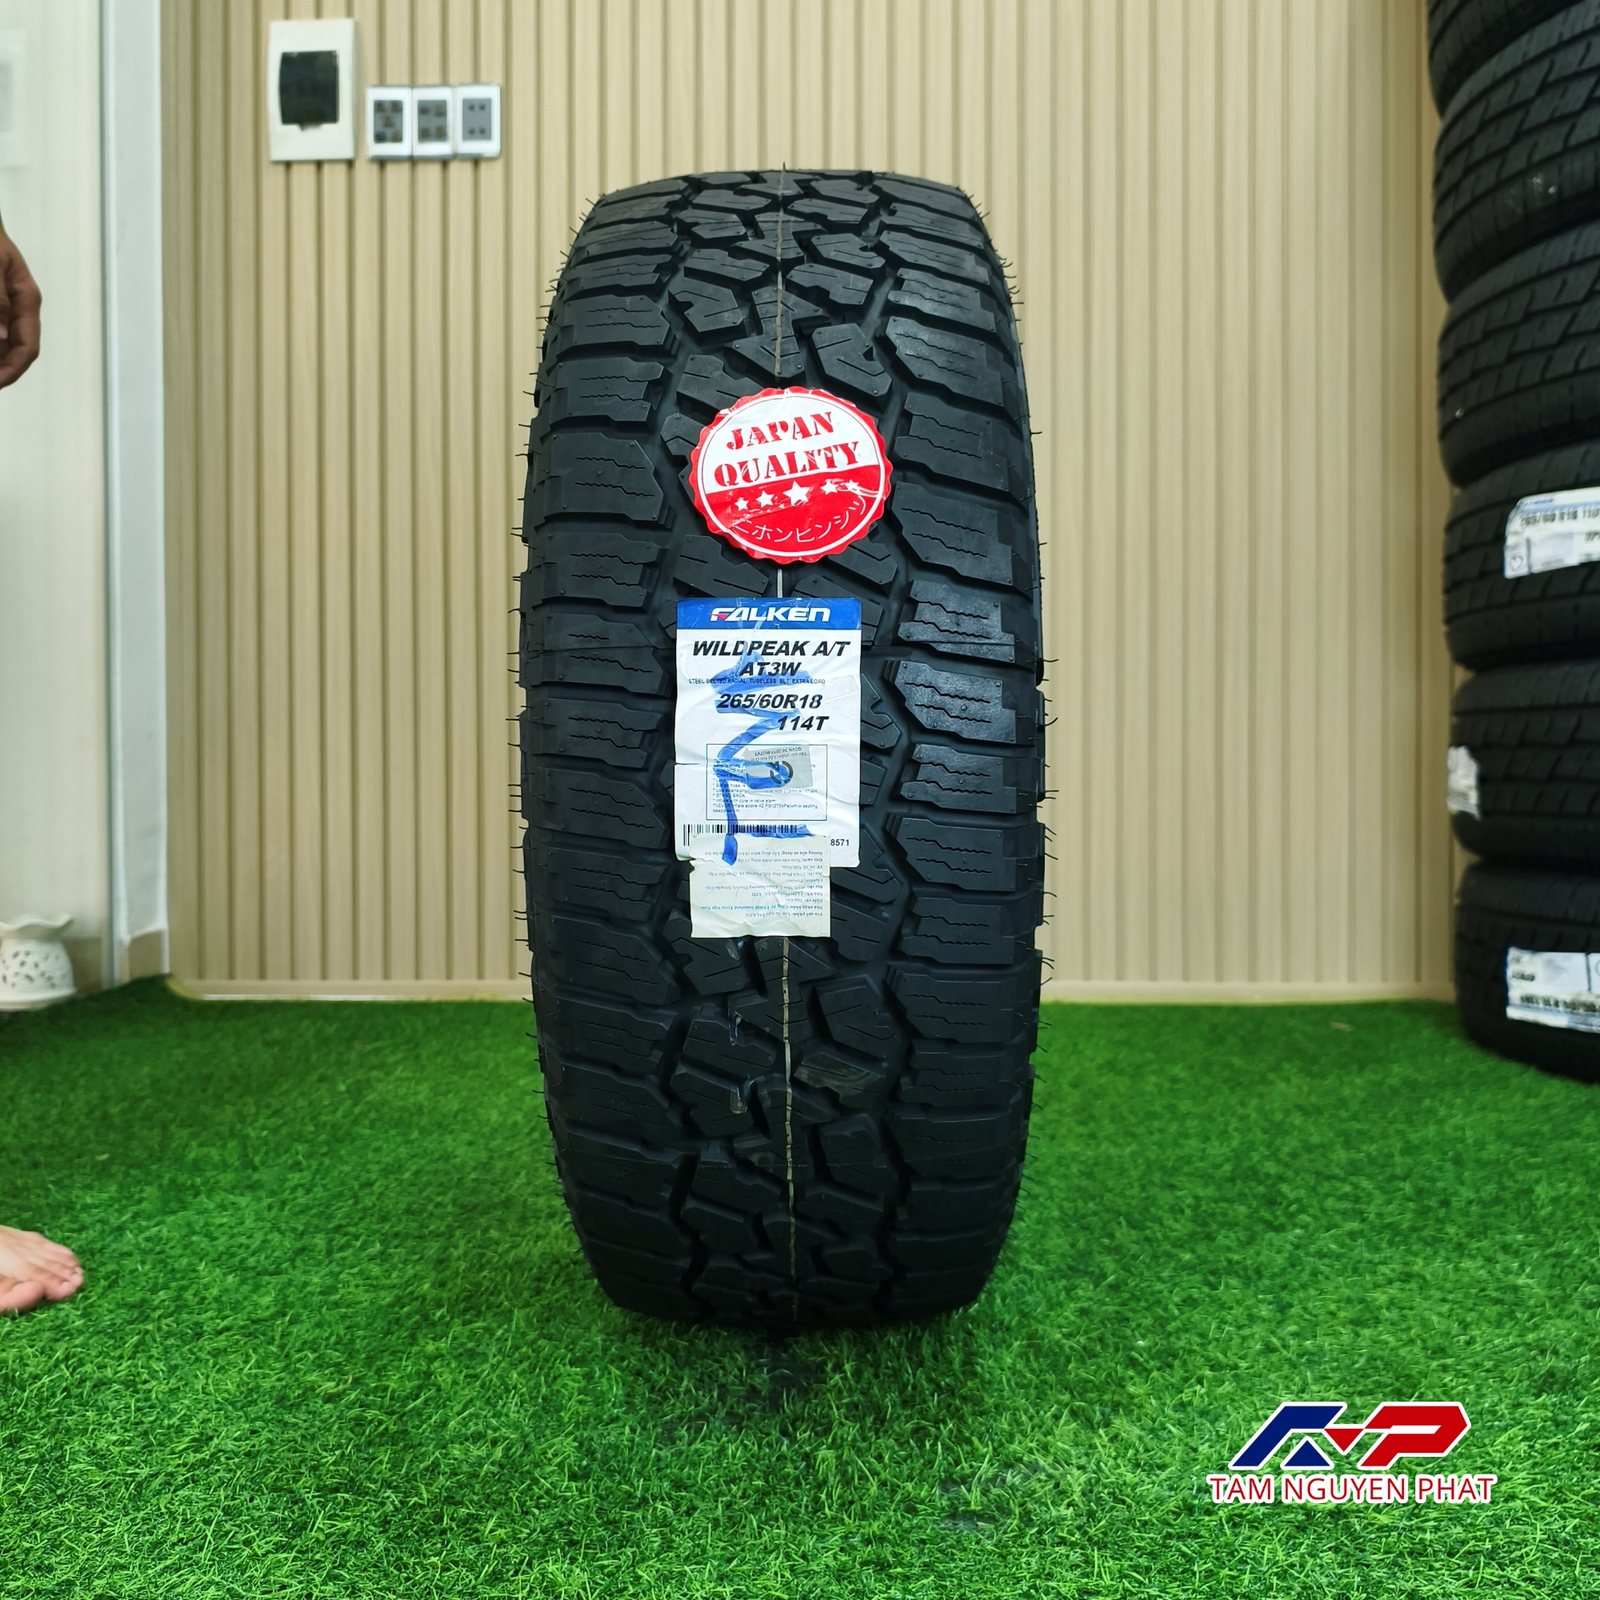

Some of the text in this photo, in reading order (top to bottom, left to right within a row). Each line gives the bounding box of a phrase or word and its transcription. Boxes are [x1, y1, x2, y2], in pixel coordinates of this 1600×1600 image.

[726, 411, 834, 450] JAPAN
[714, 441, 860, 487] QUALITY
[709, 606, 831, 622] FALKEN
[693, 640, 851, 657] WILDPEAK A/T
[739, 661, 803, 677] AT3W
[716, 693, 823, 710] 265/60R18
[777, 715, 830, 731] 114T
